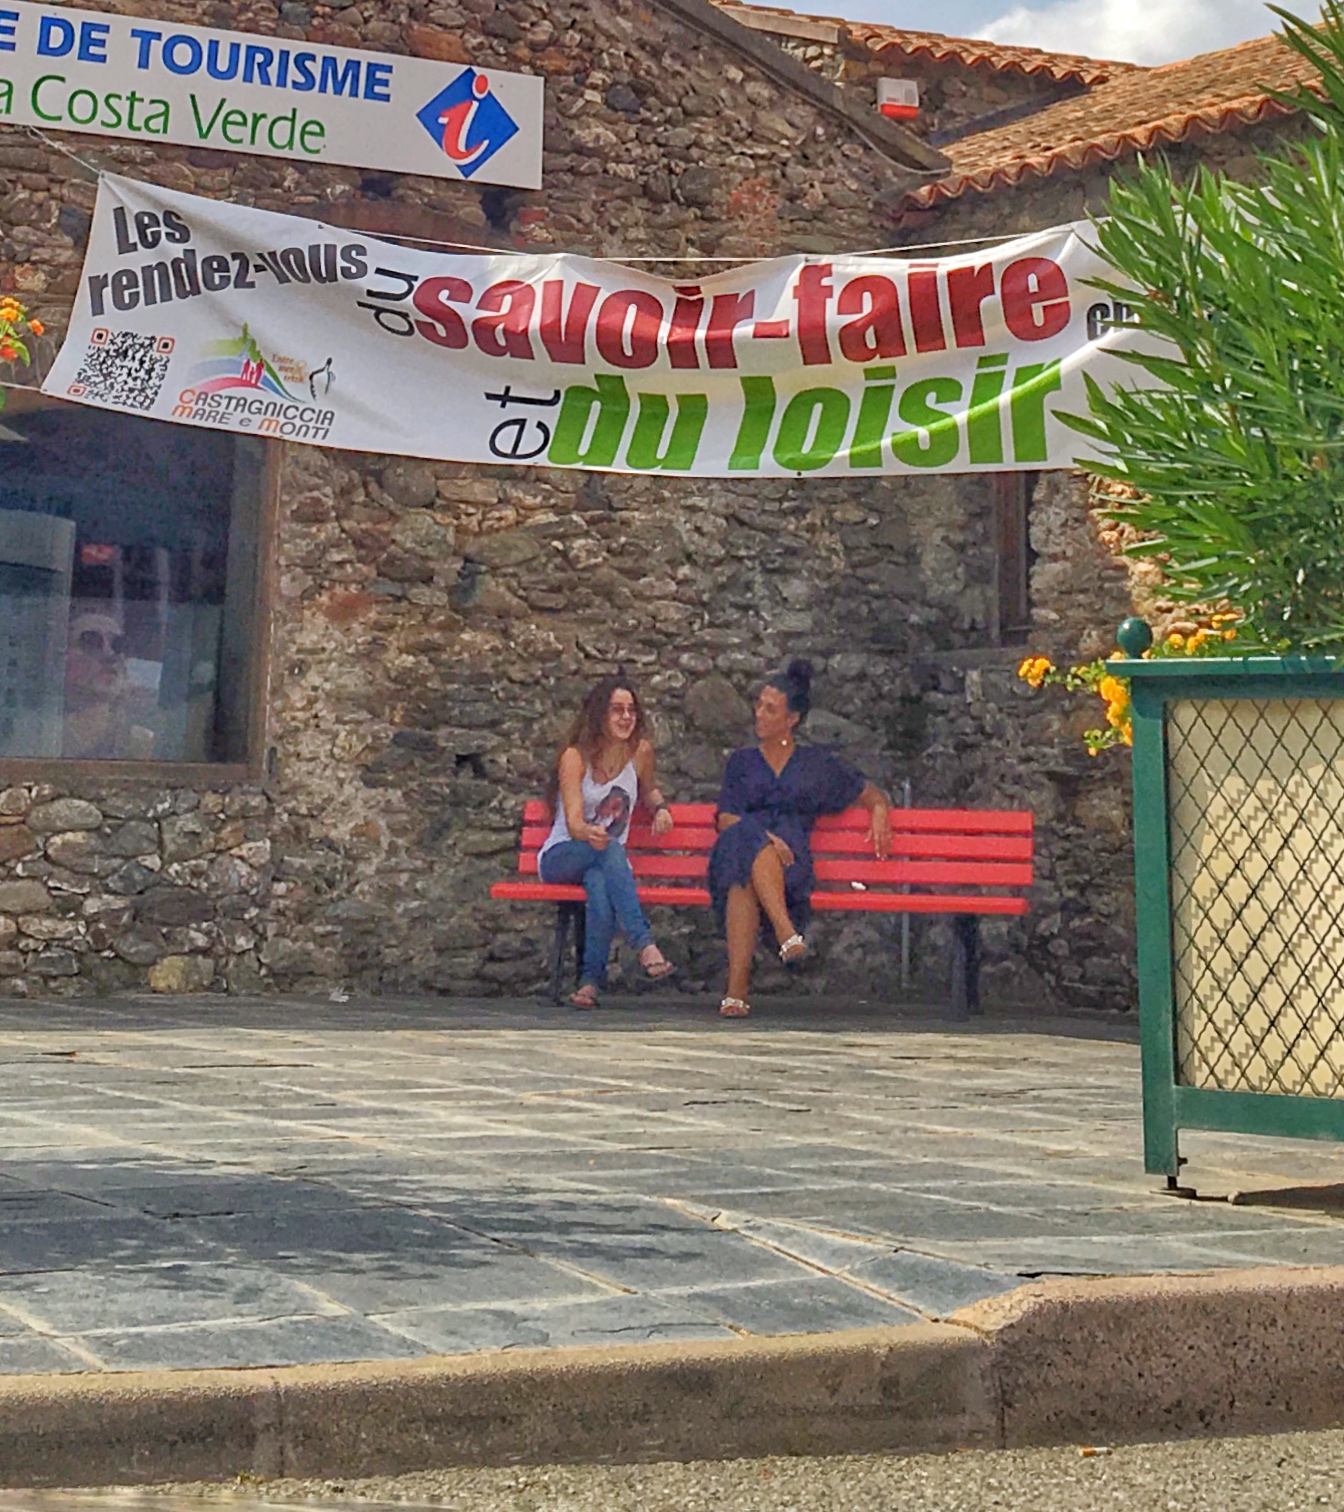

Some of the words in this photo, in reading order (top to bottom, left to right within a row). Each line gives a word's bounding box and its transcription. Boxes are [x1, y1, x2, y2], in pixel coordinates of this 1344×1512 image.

[36, 15, 110, 64] DE
[130, 28, 394, 103] TOURISME
[30, 74, 170, 135] Costa
[189, 93, 325, 155] Verde
[113, 206, 192, 255] Les
[88, 243, 368, 317] rendez-vous
[357, 267, 419, 337] du
[413, 256, 1071, 369] savoir-faire
[179, 389, 335, 427] CASTAGNICCIA
[484, 385, 561, 459] et
[547, 373, 709, 471] du
[727, 352, 1062, 471] loisir
